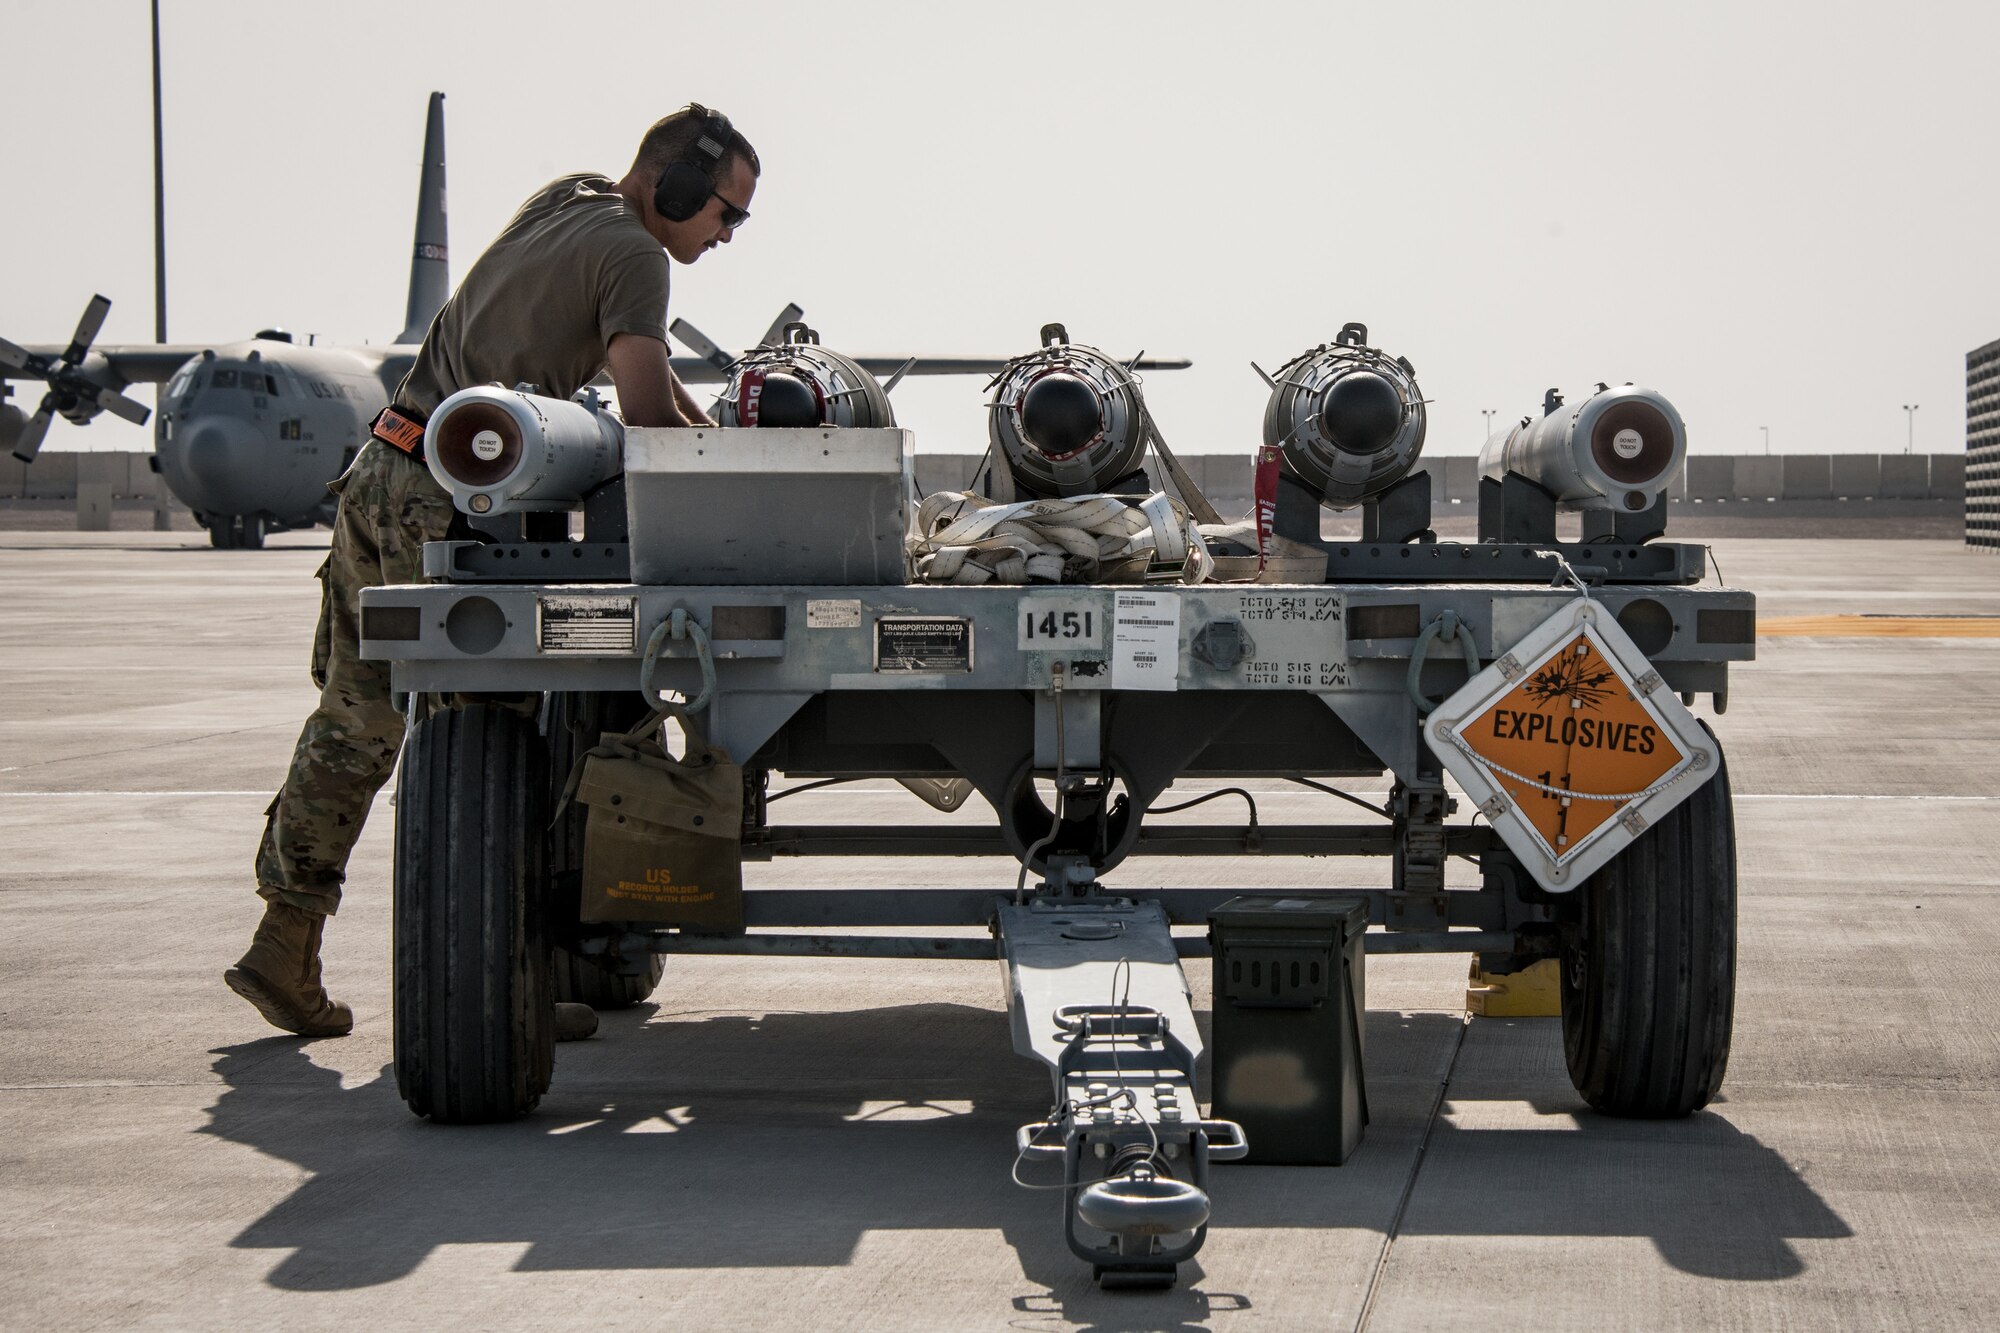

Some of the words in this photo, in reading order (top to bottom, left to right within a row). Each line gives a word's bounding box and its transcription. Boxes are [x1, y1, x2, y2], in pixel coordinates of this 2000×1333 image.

[1240, 598, 1272, 607] TCTO
[1240, 610, 1273, 620] TCTO
[1027, 611, 1092, 639] 1451
[1246, 662, 1278, 671] TCTO
[1287, 662, 1311, 672] 515
[1246, 674, 1278, 683] TCTO
[1493, 709, 1656, 755] EXPLOSIVES
[646, 868, 671, 883] US
[618, 881, 661, 893] RECORDS
[662, 885, 699, 894] HOLDER
[631, 892, 653, 900] STAY
[655, 895, 678, 903] WITH
[680, 892, 716, 904] ENGINE
